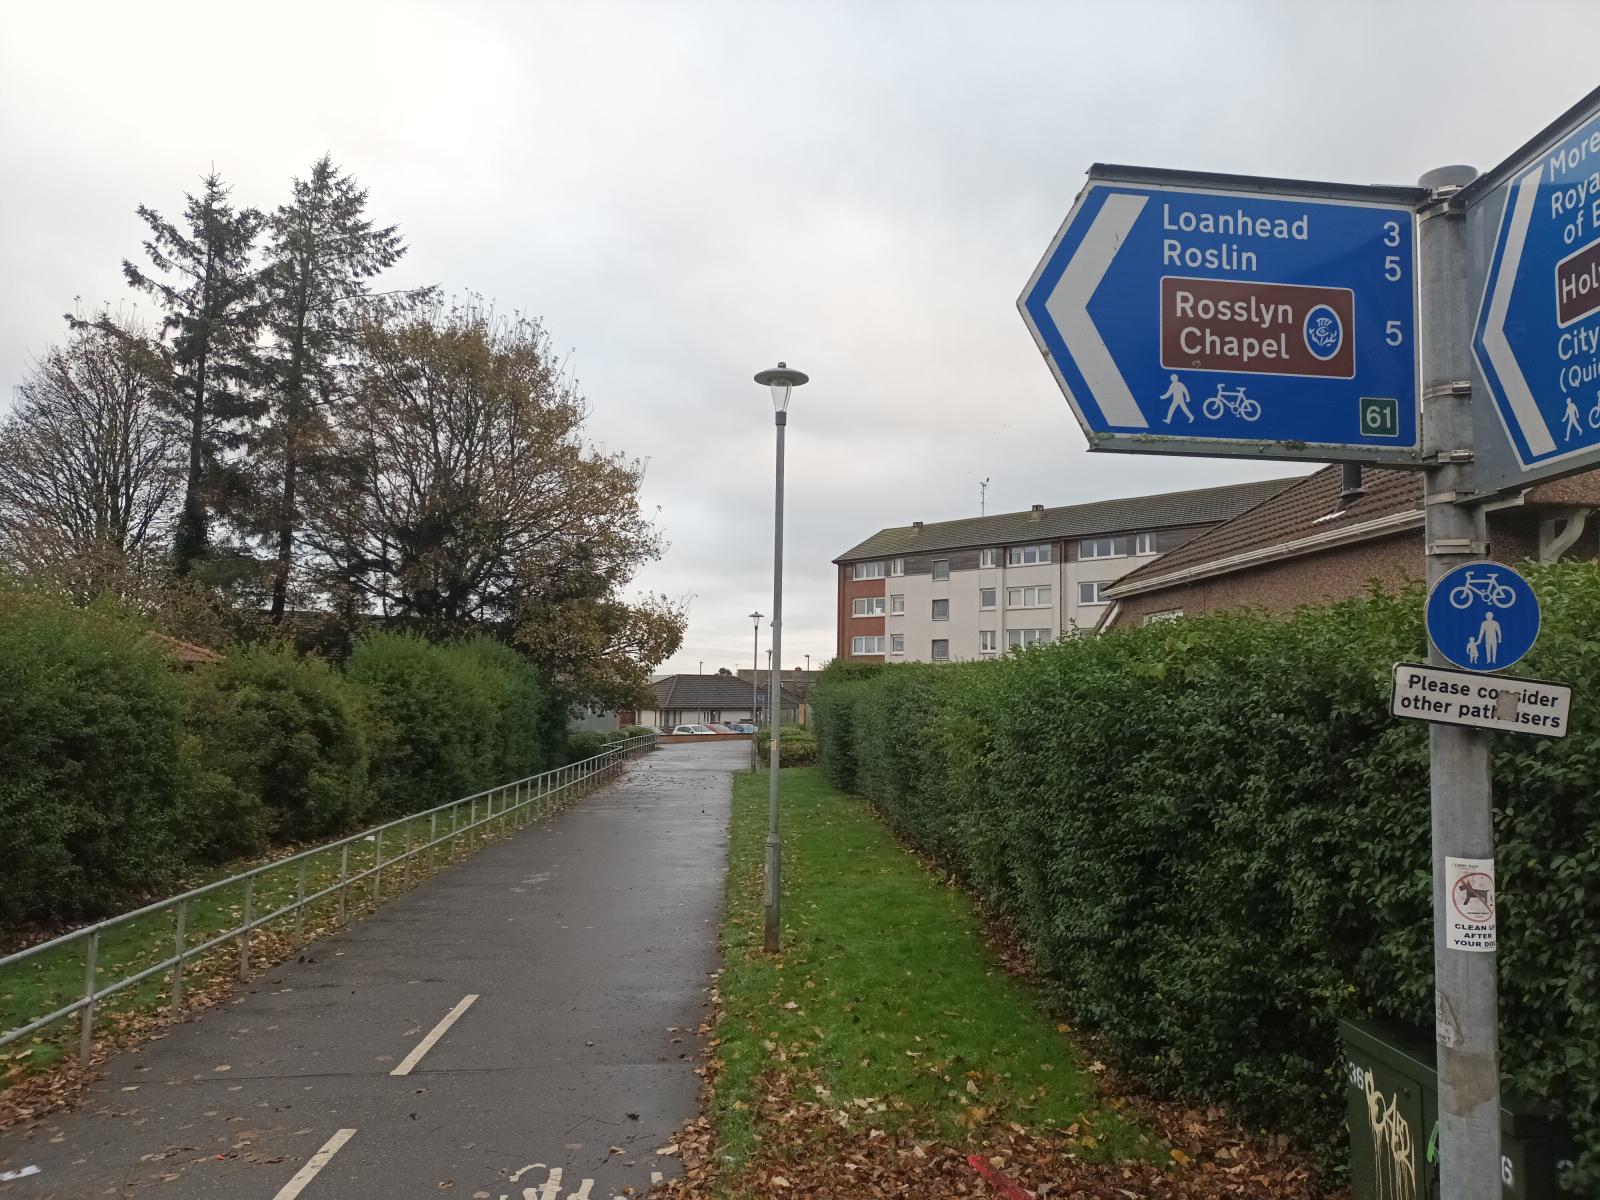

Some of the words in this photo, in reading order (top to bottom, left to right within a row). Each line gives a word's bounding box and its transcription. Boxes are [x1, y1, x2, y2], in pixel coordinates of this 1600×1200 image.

[1163, 204, 1309, 240] Loanhead
[1383, 222, 1400, 247] 3
[1564, 209, 1584, 244] of
[1163, 239, 1257, 271] Roslin
[1384, 255, 1402, 282] 5
[1562, 262, 1600, 304] Hol
[1175, 291, 1293, 328] Rosslyn
[1180, 327, 1290, 362] Chapel
[1386, 321, 1402, 346] 5
[1558, 326, 1600, 361] City
[1560, 358, 1600, 393] (Qui
[1365, 406, 1391, 429] 61
[1401, 695, 1451, 714] other
[1408, 674, 1470, 695] Please
[1477, 687, 1559, 708] coider
[1454, 939, 1481, 947] YOUR
[1455, 923, 1487, 931] CLEAN
[1349, 1061, 1364, 1090] 36
